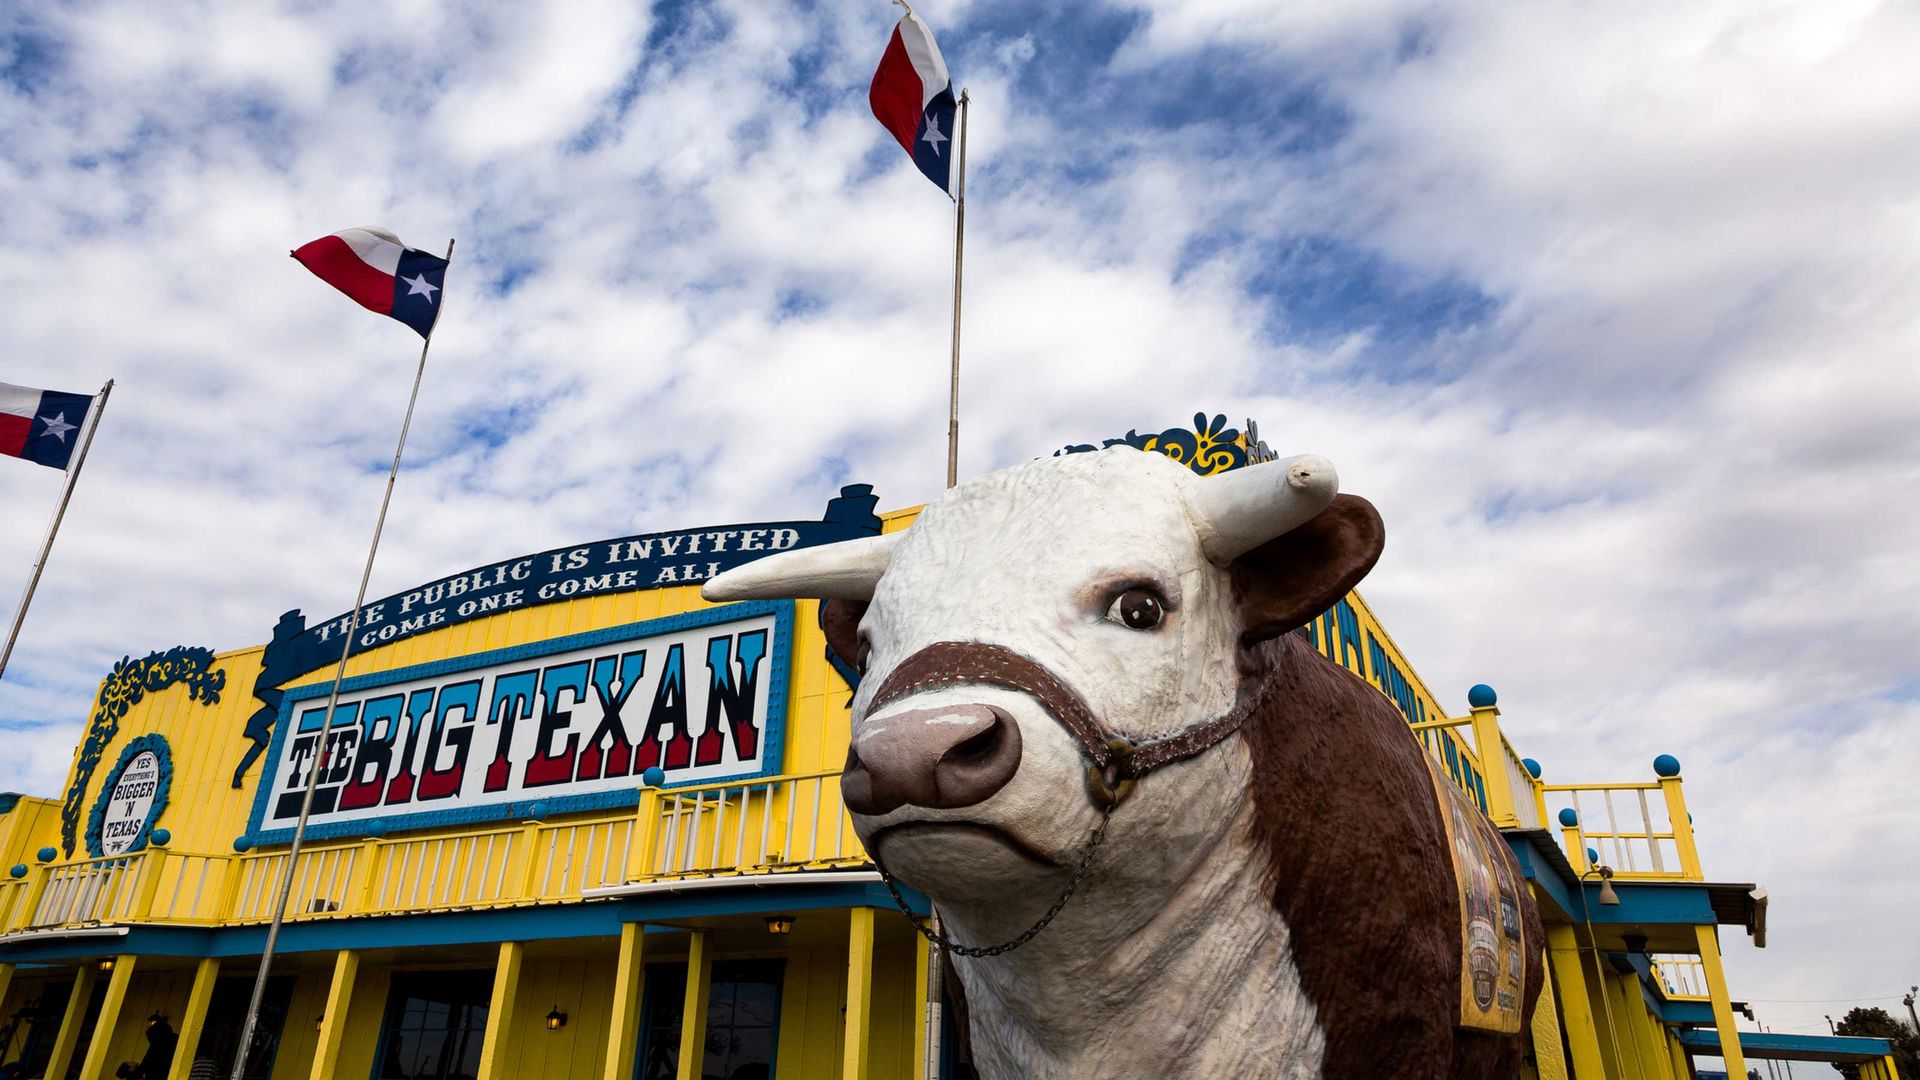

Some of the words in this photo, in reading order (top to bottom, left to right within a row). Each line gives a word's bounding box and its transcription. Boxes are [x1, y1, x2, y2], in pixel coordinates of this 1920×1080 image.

[315, 603, 385, 644] THE
[398, 559, 533, 614] PUBLIC
[549, 548, 590, 574] IS
[605, 528, 800, 564] INVITED
[360, 607, 447, 647] COME
[457, 589, 525, 616] ONE
[538, 569, 638, 599] COME
[652, 561, 726, 584] ALL
[337, 676, 485, 811] BIG
[482, 628, 768, 793] TEXAN
[136, 757, 152, 770] YES
[114, 781, 155, 801] BIGGER
[106, 818, 141, 838] TEXAS
